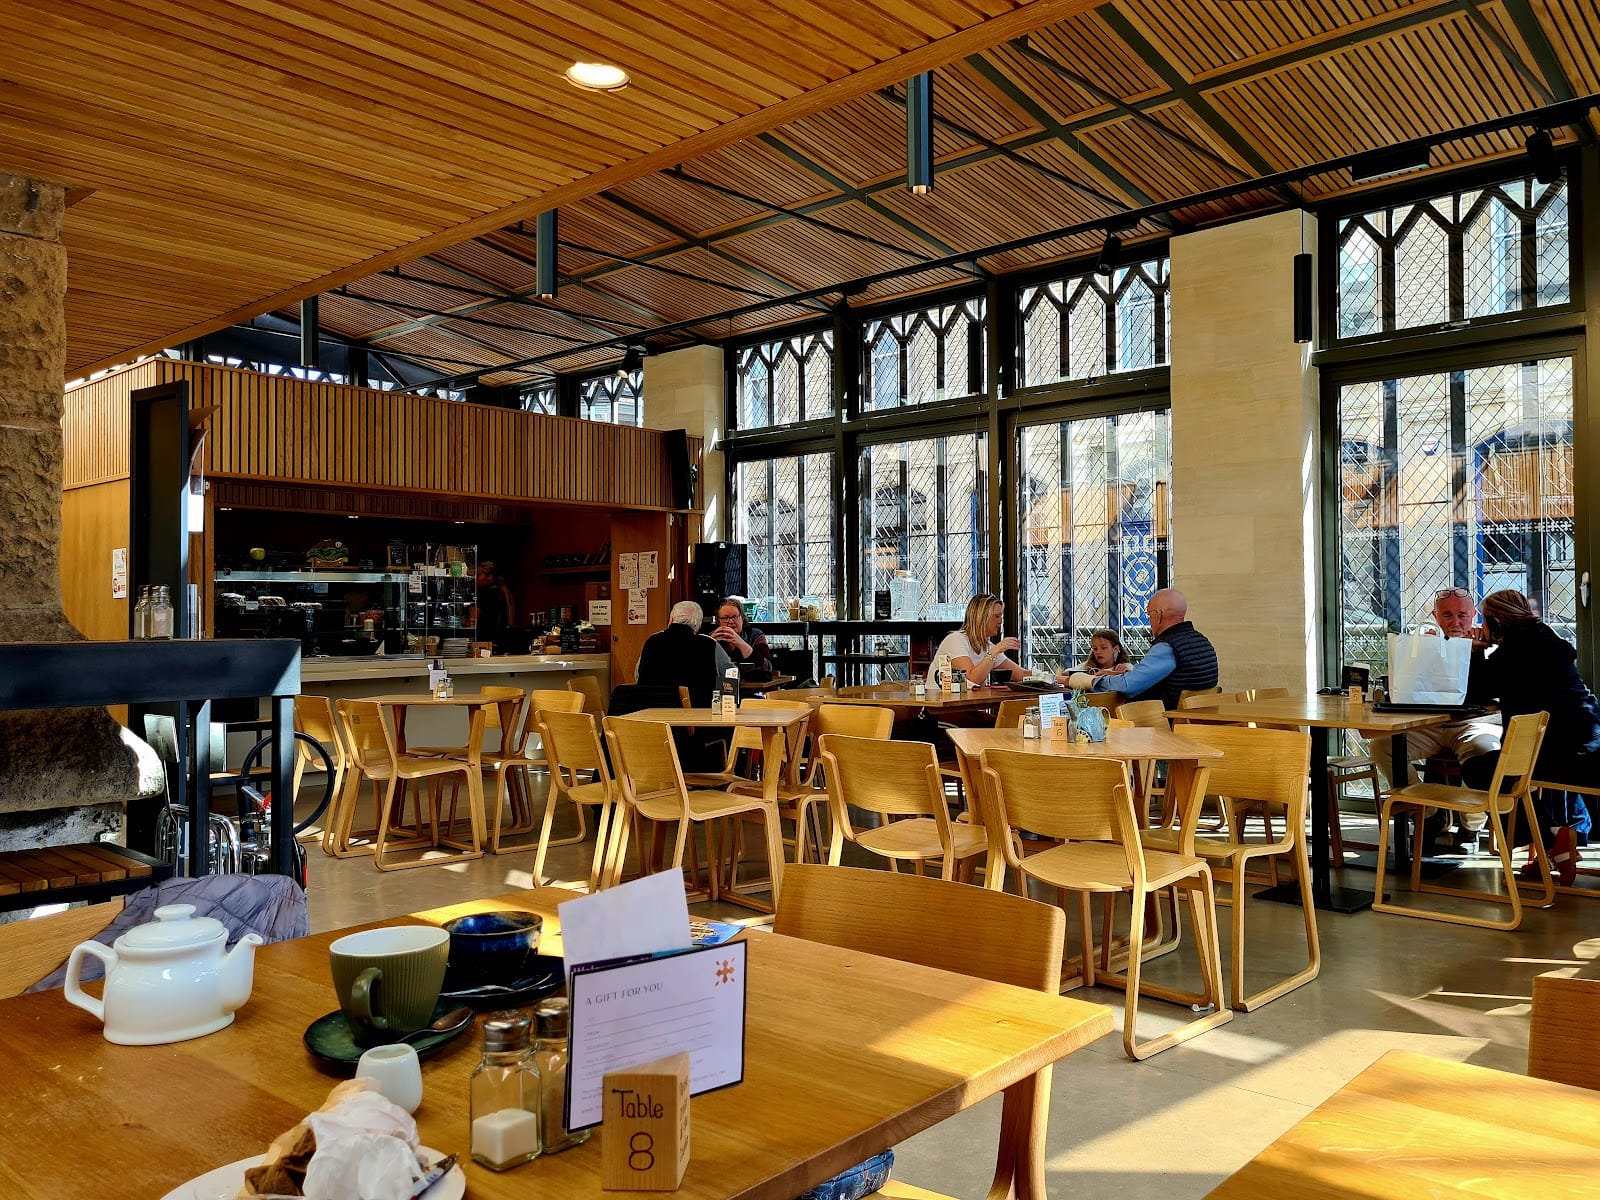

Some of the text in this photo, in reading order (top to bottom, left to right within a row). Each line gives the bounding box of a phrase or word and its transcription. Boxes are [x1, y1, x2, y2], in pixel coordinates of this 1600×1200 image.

[585, 981, 664, 1006] A GIFT FOR YOU
[612, 1088, 664, 1119] Table
[628, 1131, 655, 1171] 8
